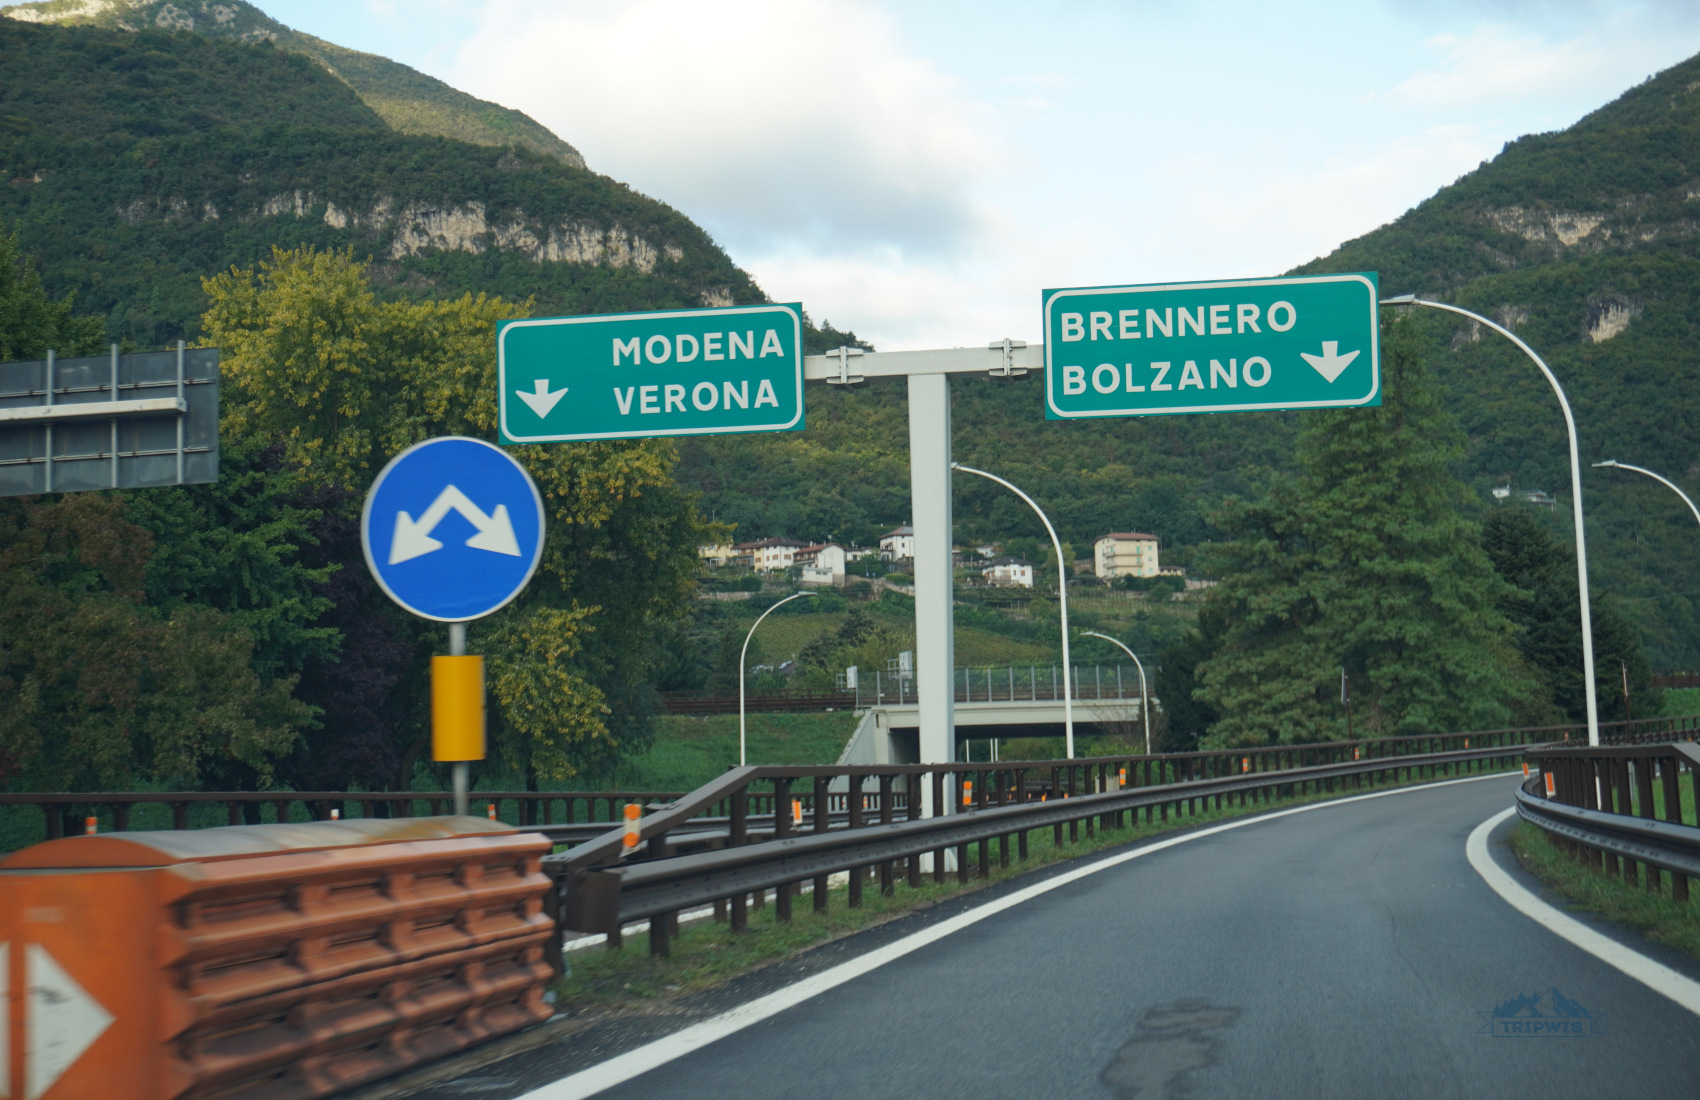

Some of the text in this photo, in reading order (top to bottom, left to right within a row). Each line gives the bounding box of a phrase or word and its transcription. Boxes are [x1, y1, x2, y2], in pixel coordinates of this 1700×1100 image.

[1061, 300, 1297, 342] BRENNERO
[612, 329, 785, 367] MODENA
[1062, 356, 1272, 396] BOLZANO
[613, 379, 780, 415] VERONA
